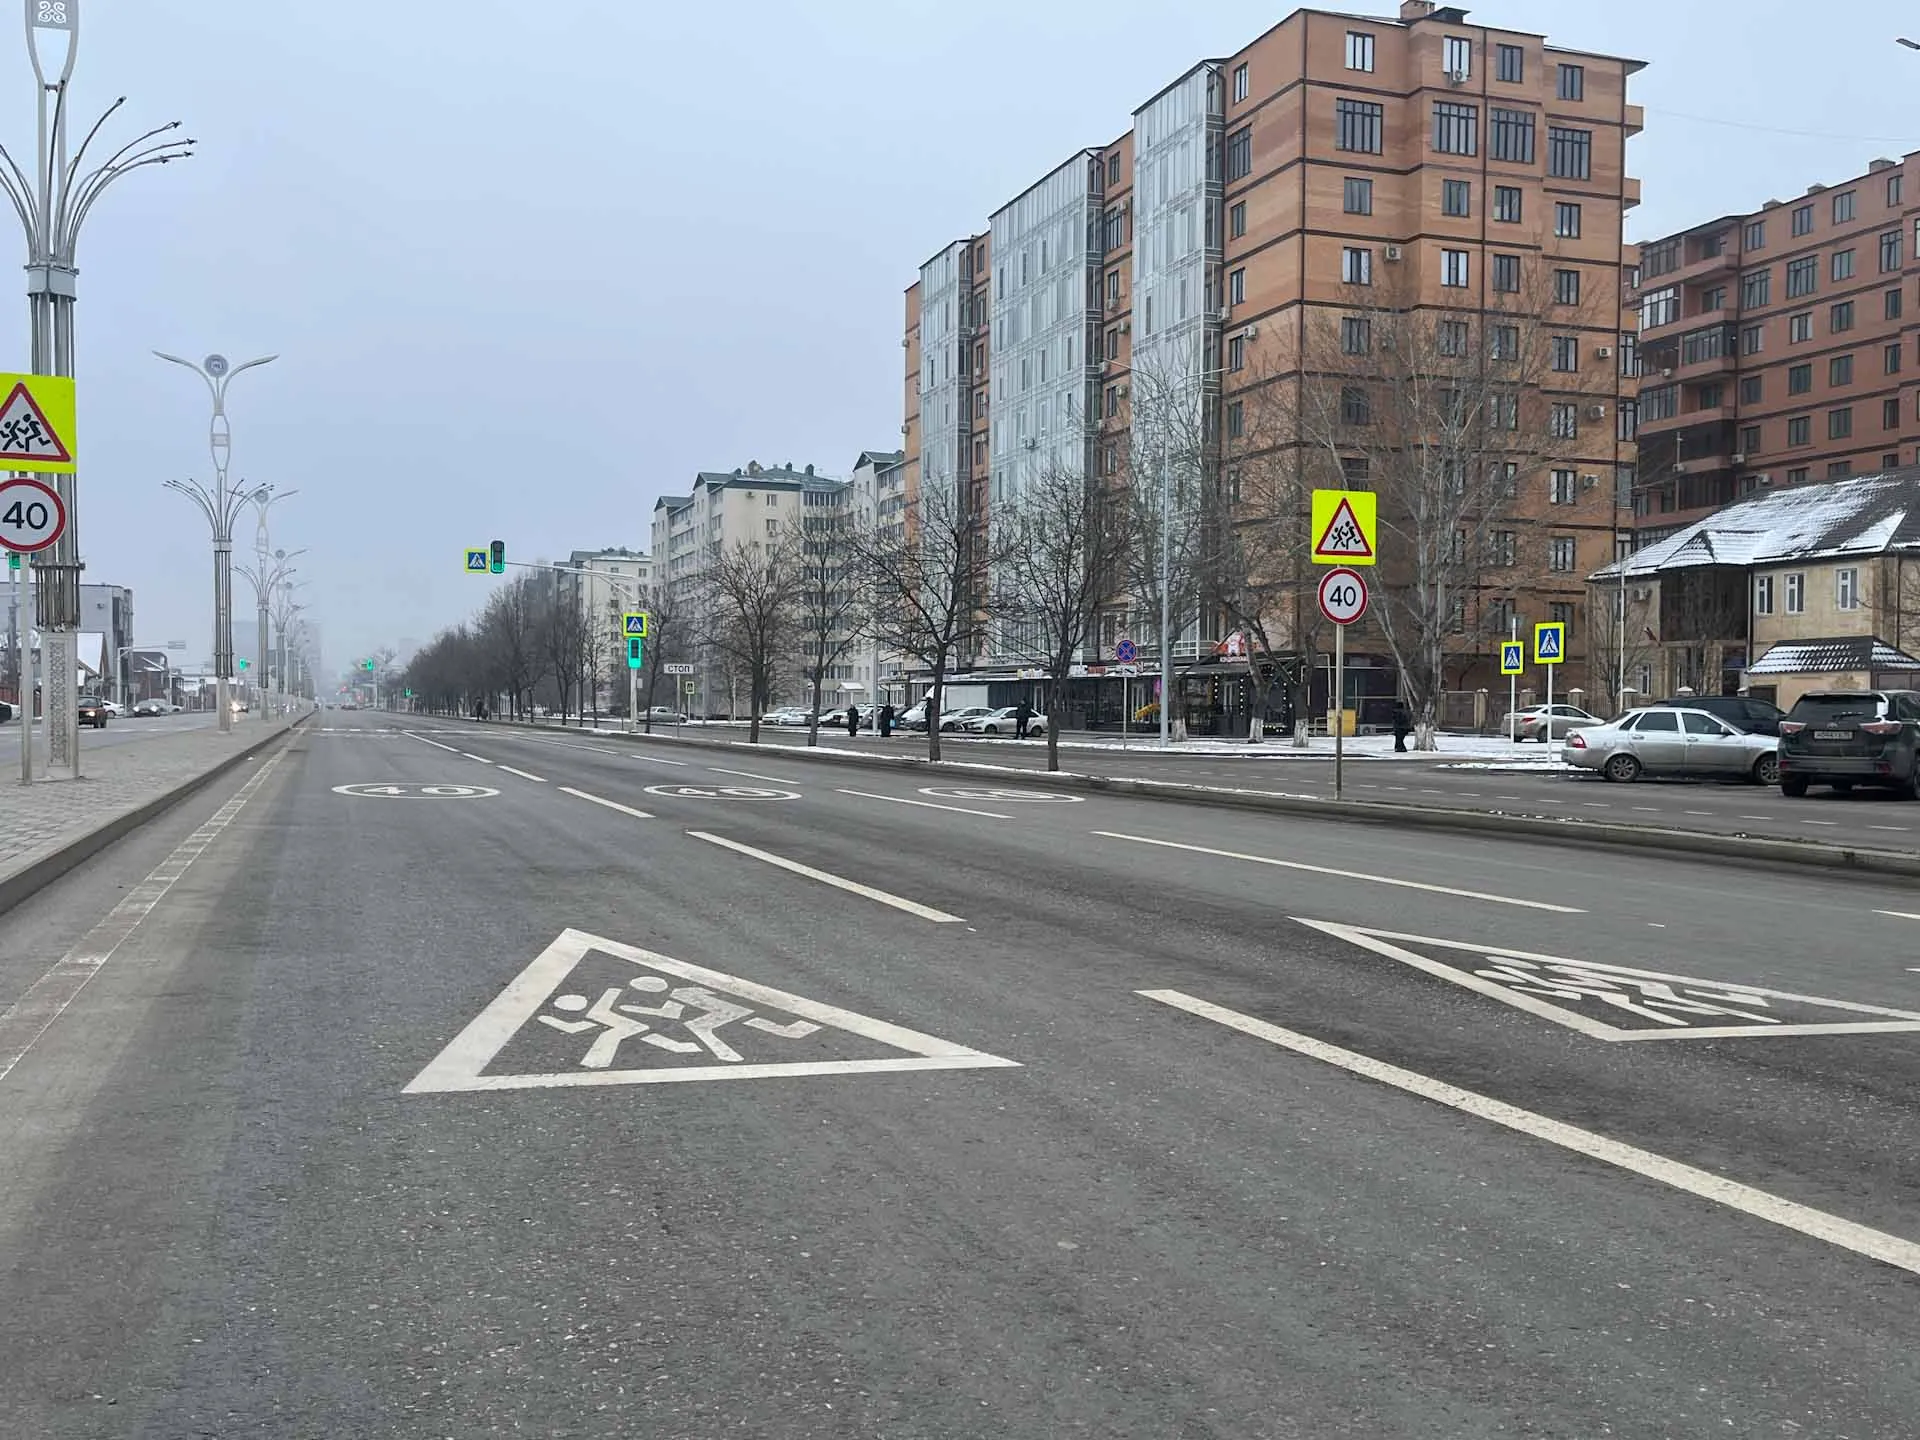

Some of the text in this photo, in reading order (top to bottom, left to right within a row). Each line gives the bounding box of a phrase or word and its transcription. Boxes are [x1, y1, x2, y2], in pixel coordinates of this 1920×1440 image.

[2, 501, 49, 530] 40
[1329, 585, 1357, 607] 40
[667, 665, 690, 673] СТОП
[363, 786, 475, 795] 40
[677, 787, 777, 796] 40
